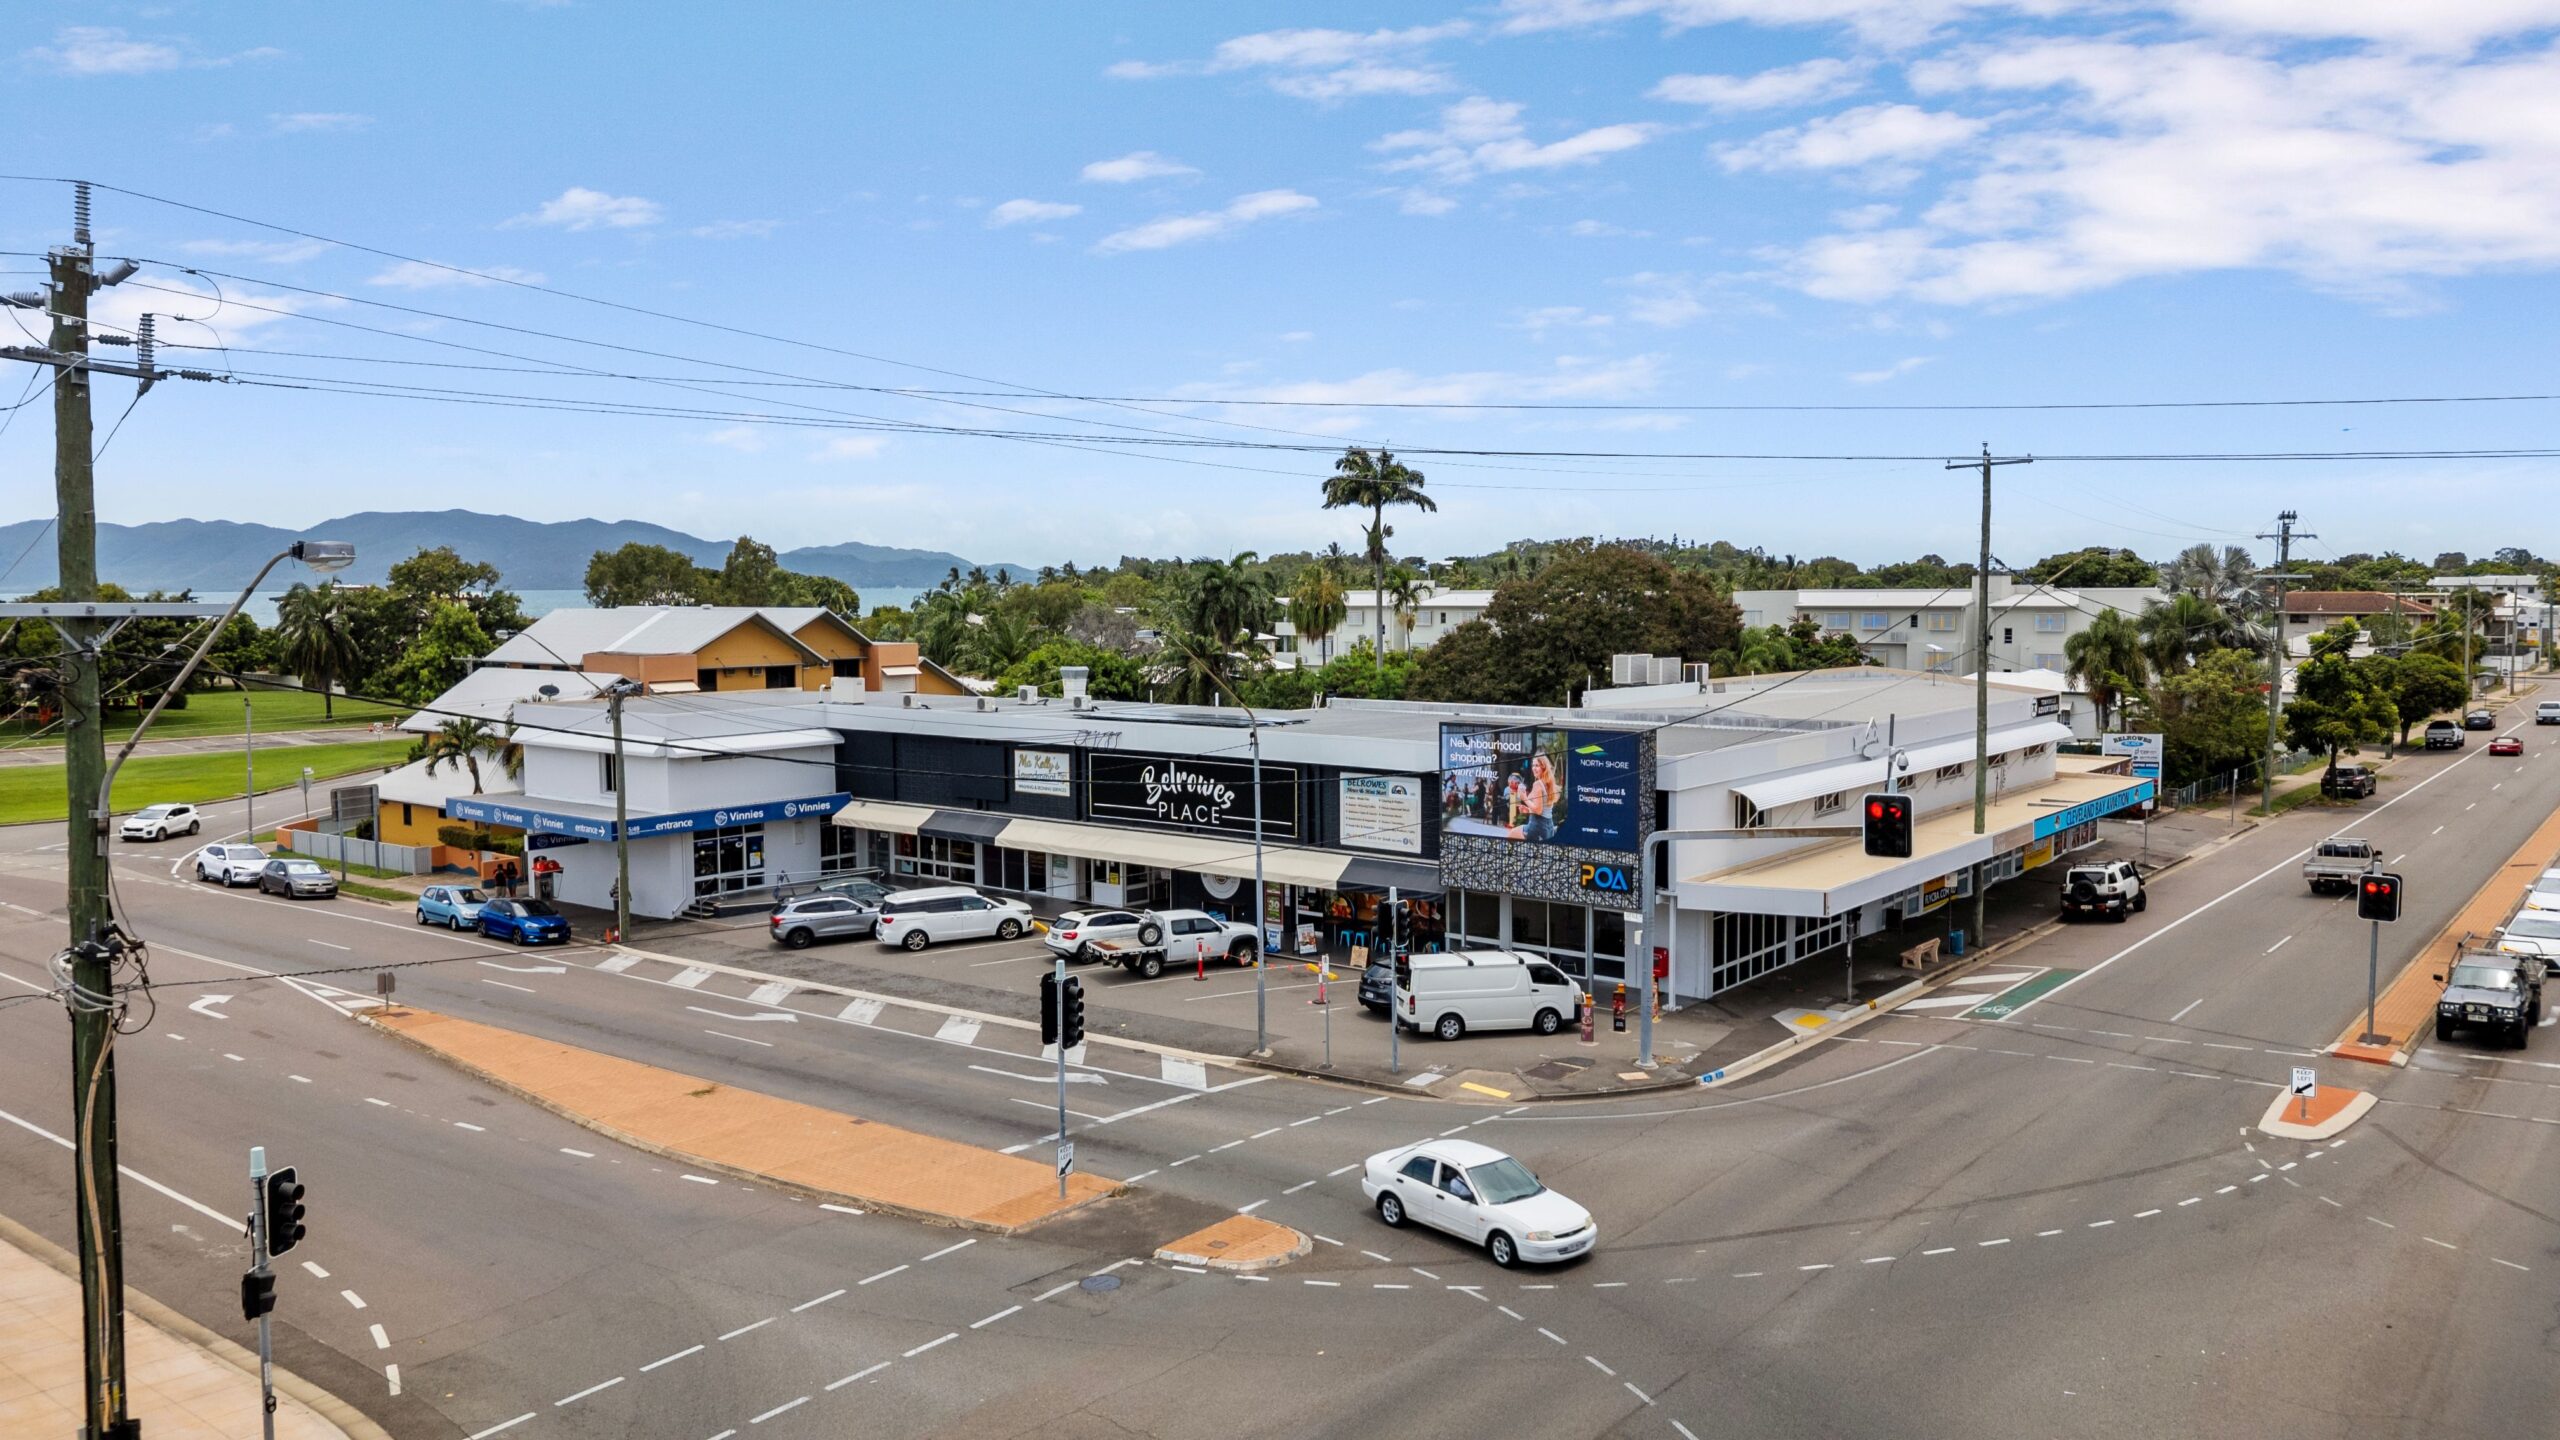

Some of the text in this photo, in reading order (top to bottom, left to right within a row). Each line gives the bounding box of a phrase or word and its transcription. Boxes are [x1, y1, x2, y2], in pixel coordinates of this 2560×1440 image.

[1450, 737, 1521, 751] Neighbourhood
[1450, 753, 1497, 765] shopping?
[1580, 759, 1630, 769] NORTH SHORE
[1140, 761, 1235, 809] Belrowes
[1347, 779, 1387, 789] BELROWES
[1577, 785, 1603, 793] Premium
[1604, 787, 1620, 795] Land
[464, 806, 484, 817] Vinnies
[798, 801, 831, 813] Vinnies
[1158, 801, 1220, 824] PLACE
[2066, 791, 2130, 826] CLEVELAND BAY AVIATION
[502, 811, 523, 823] Vinnies
[729, 809, 764, 821] Vinnies
[542, 819, 564, 830] Vinnies
[575, 824, 598, 835] entrance
[656, 819, 694, 831] entrance
[1581, 864, 1628, 891] POA
